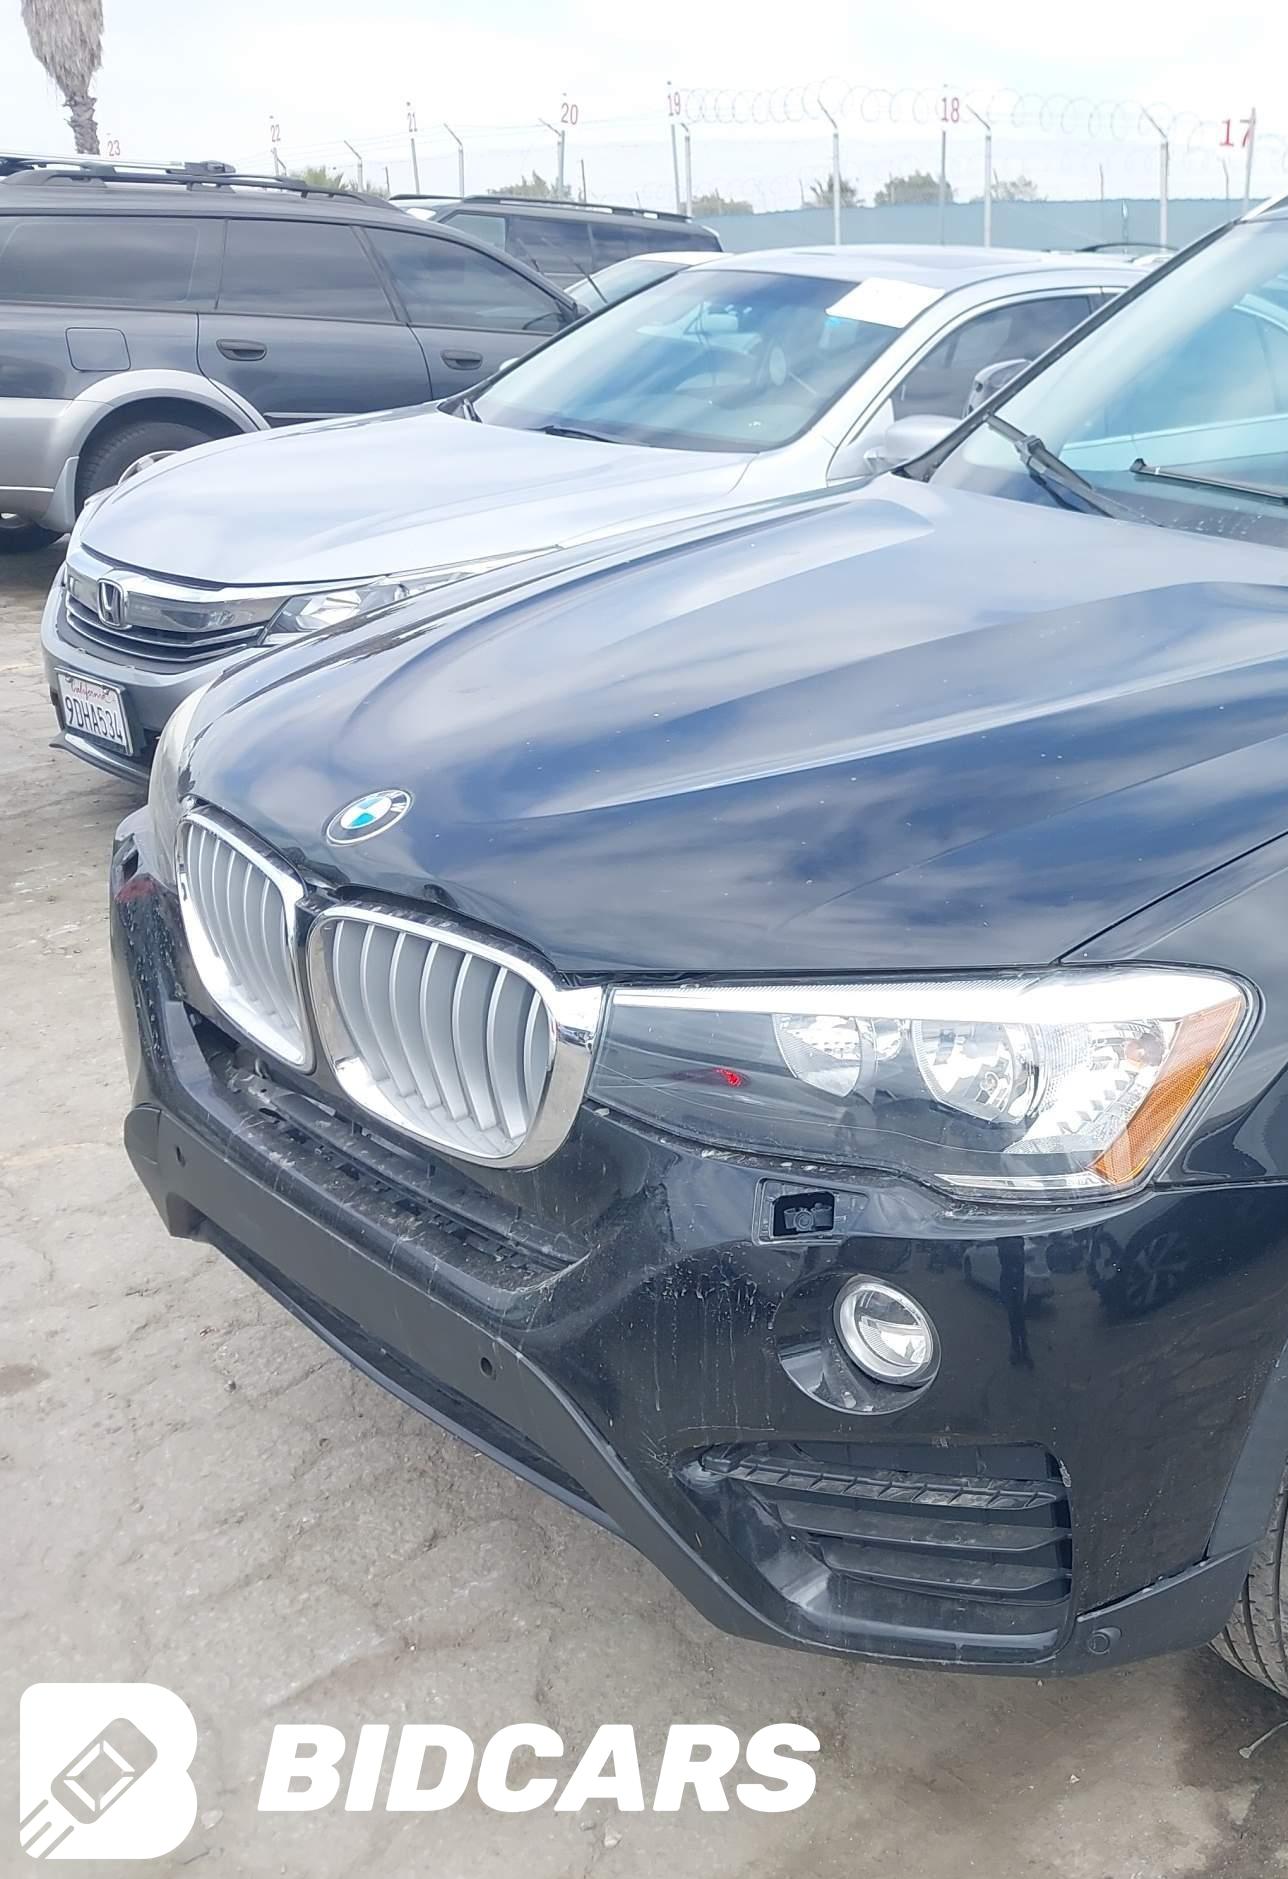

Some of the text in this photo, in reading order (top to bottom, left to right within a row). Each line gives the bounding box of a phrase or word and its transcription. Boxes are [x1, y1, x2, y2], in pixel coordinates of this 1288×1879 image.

[560, 102, 579, 125] 20
[667, 91, 681, 116] 19
[941, 97, 960, 123] 18
[270, 123, 281, 143] 22
[407, 111, 418, 133] 21
[1219, 118, 1255, 148] 17
[107, 139, 121, 157] 23
[65, 696, 123, 741] 9DHA534
